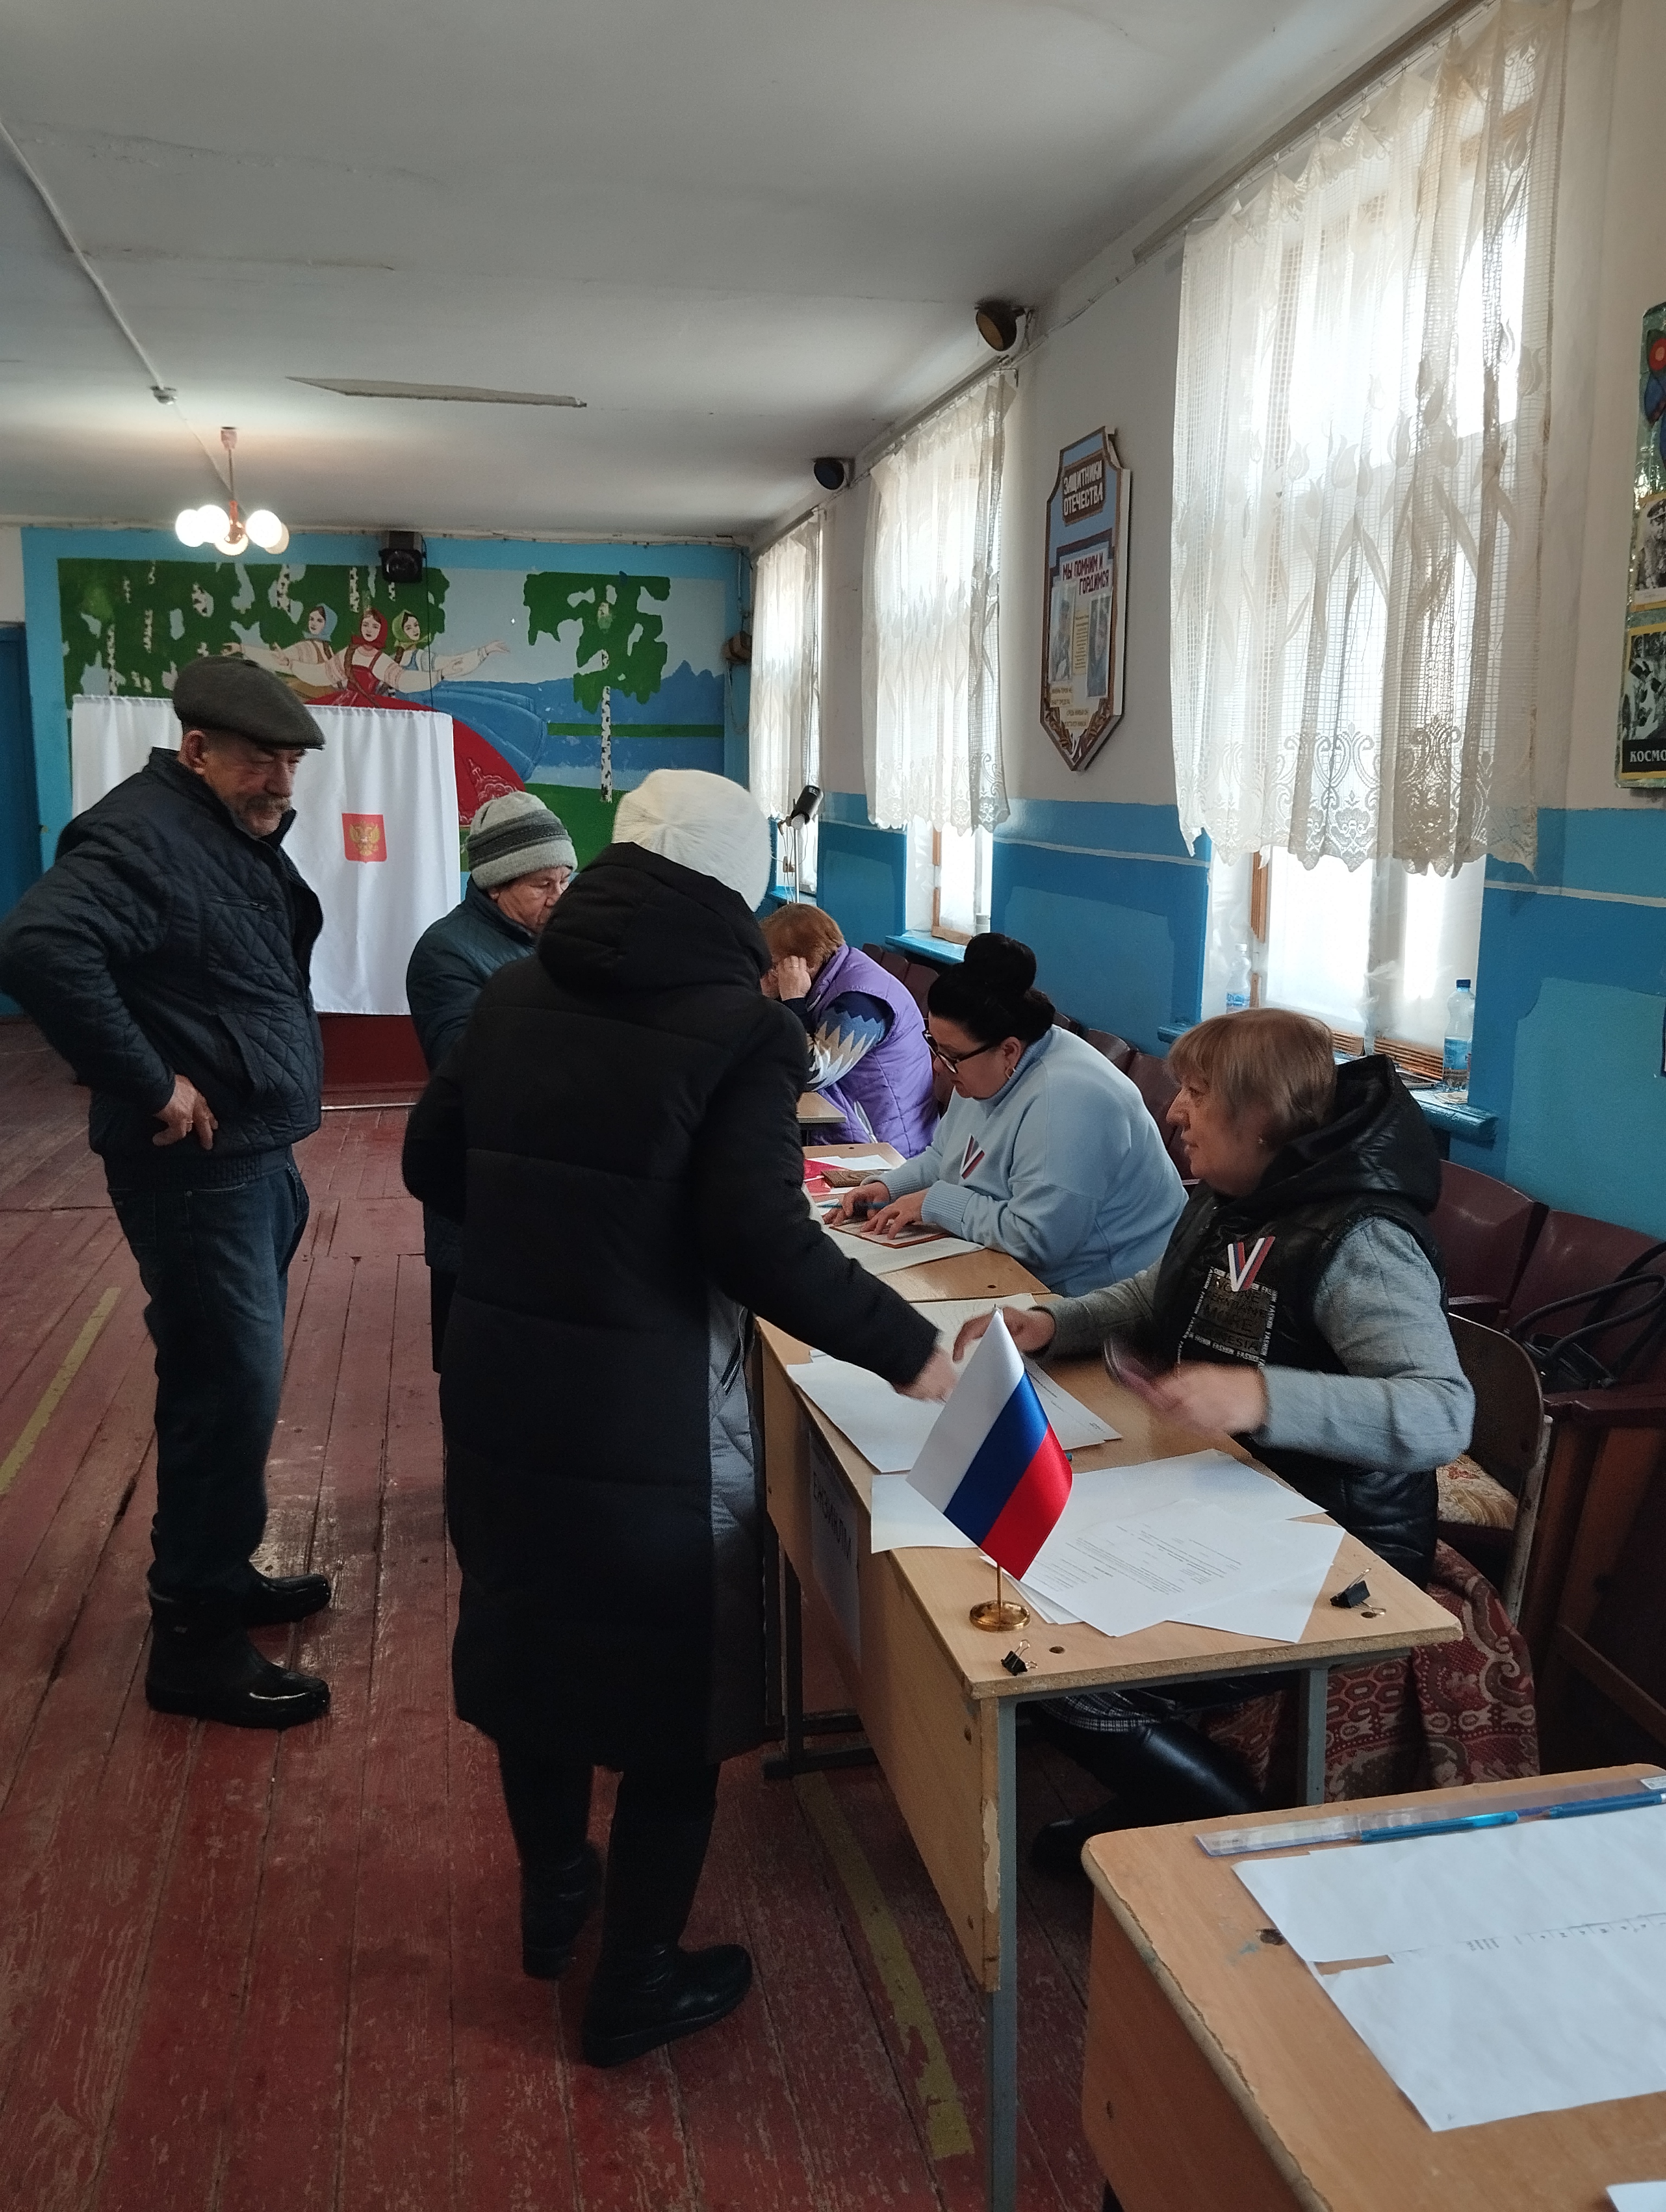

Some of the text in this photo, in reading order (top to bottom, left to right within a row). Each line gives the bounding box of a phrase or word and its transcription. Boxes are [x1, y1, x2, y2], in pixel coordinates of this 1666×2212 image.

[1063, 460, 1102, 495] ЗАЩИТНИКИ
[1063, 481, 1103, 516] ОТЕЧЕСТВА
[1063, 552, 1103, 581] МЫ ПОМНИМ И
[1079, 569, 1109, 595] ГОРДИМСЯ
